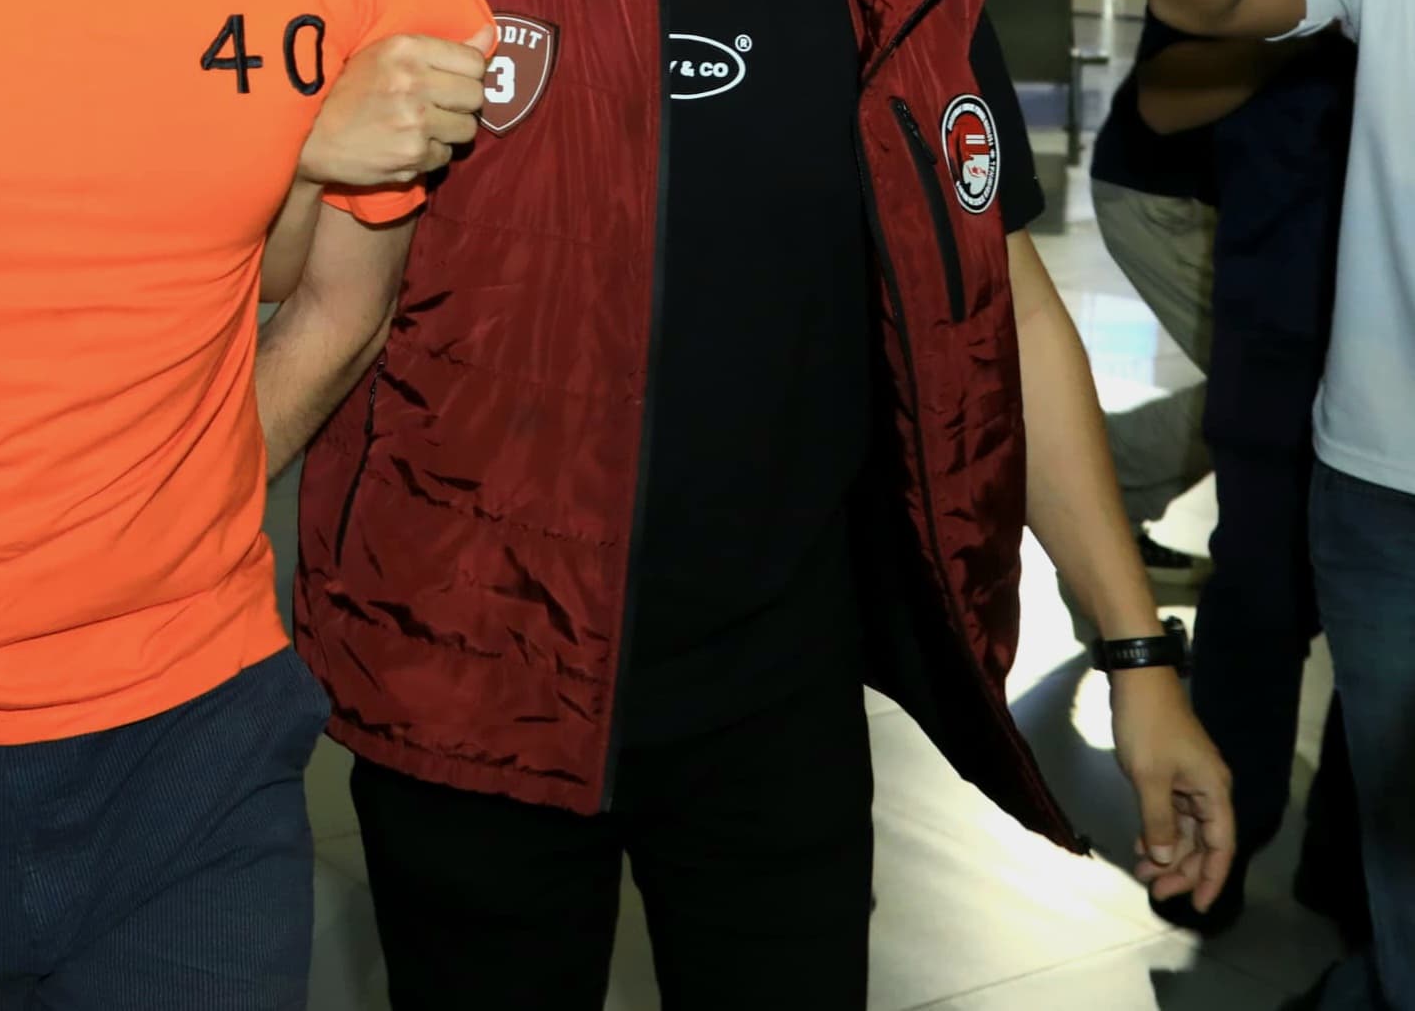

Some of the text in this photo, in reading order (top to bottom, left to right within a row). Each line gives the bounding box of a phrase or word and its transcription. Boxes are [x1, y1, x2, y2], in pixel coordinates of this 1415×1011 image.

[200, 13, 326, 97] 40
[483, 55, 516, 104] 3
[680, 60, 695, 77] &
[699, 61, 729, 78] CO
